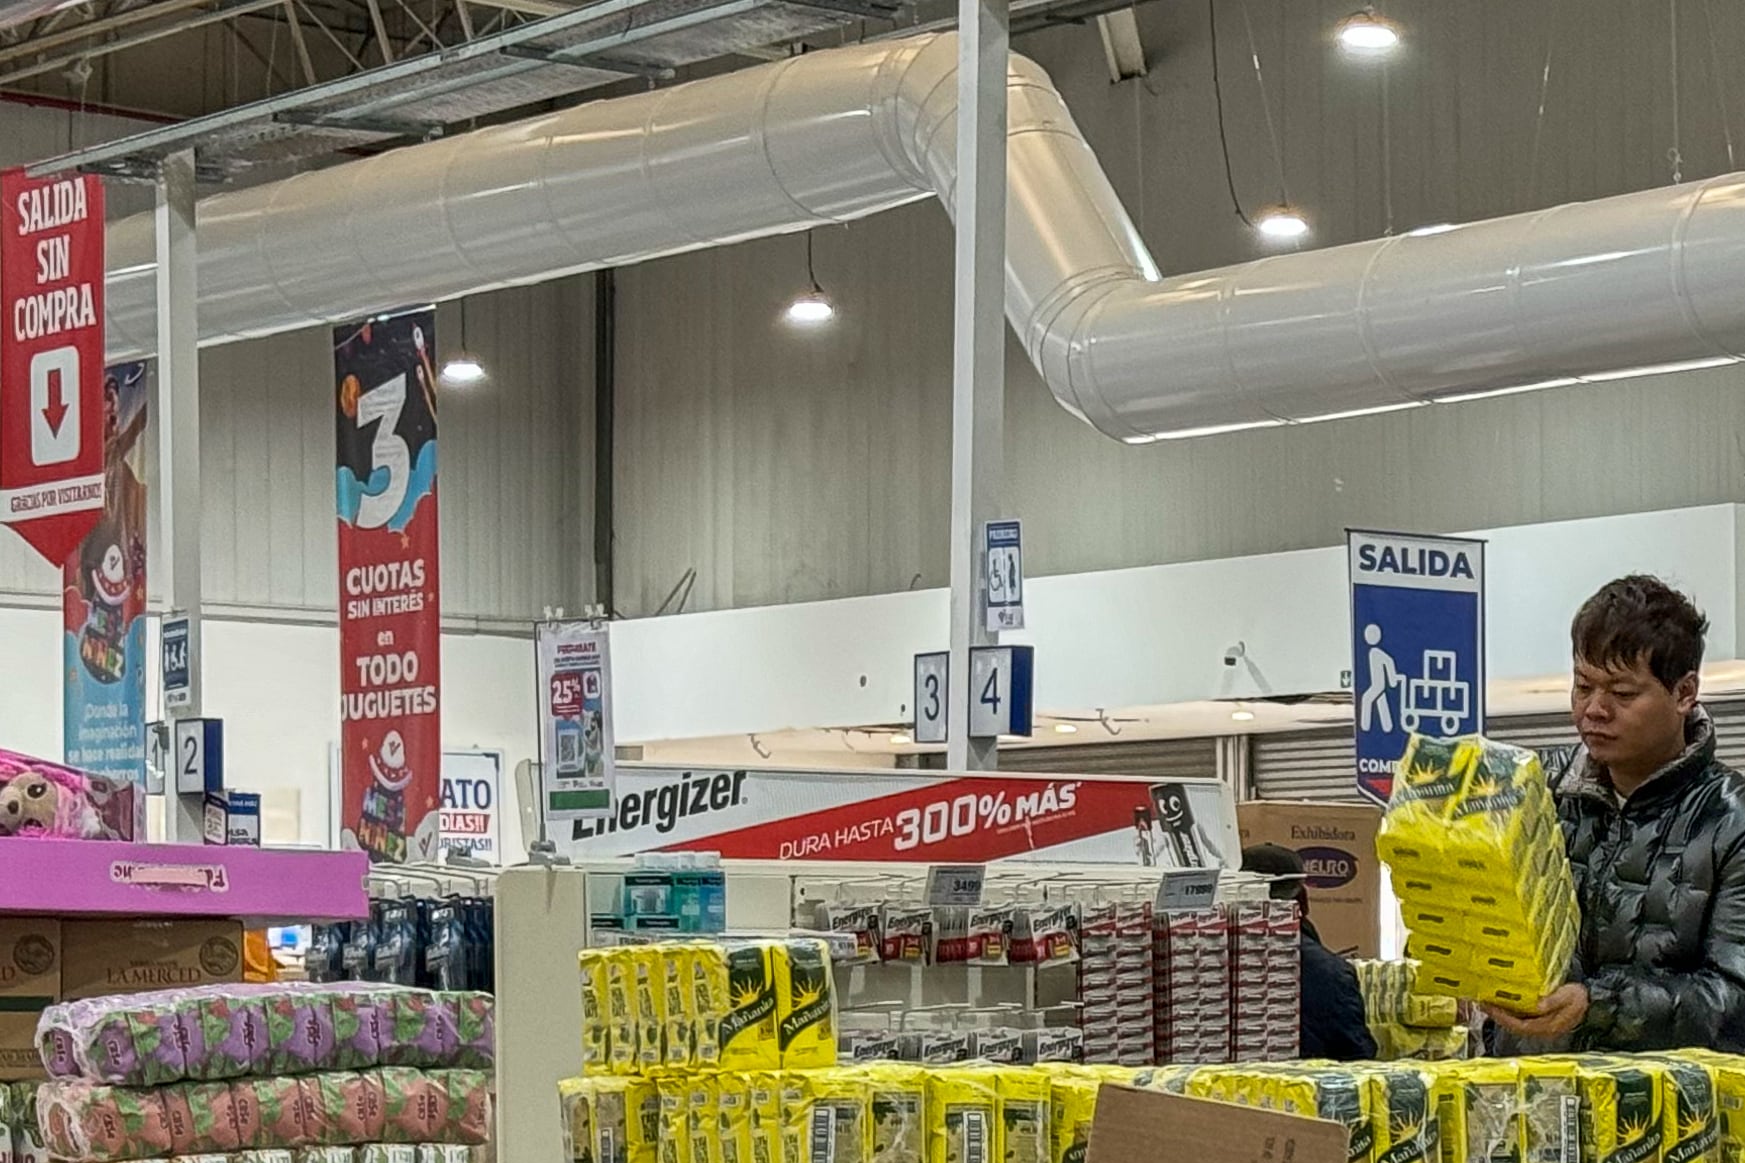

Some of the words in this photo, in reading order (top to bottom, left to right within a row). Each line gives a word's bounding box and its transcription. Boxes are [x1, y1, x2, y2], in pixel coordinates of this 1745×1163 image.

[18, 176, 88, 236] SALIDA
[36, 235, 71, 284] SIN
[13, 283, 97, 341] COMPRA
[356, 373, 410, 529] 3
[346, 558, 425, 595] CUOTAS
[1359, 543, 1474, 581] SALIDA
[348, 599, 370, 620] SIN
[372, 589, 424, 616] INTERÉS
[377, 630, 394, 646] en
[356, 651, 418, 687] TODO
[341, 685, 436, 723] JUGUETES
[923, 674, 940, 722] 3
[981, 668, 1000, 715] 4
[183, 736, 198, 775] 2
[780, 835, 831, 860] DURA
[835, 818, 894, 848] HASTA
[894, 792, 1011, 850] 300%
[1291, 825, 1356, 840] Exhibidora
[108, 968, 128, 984] LA
[132, 967, 200, 985] MERCED
